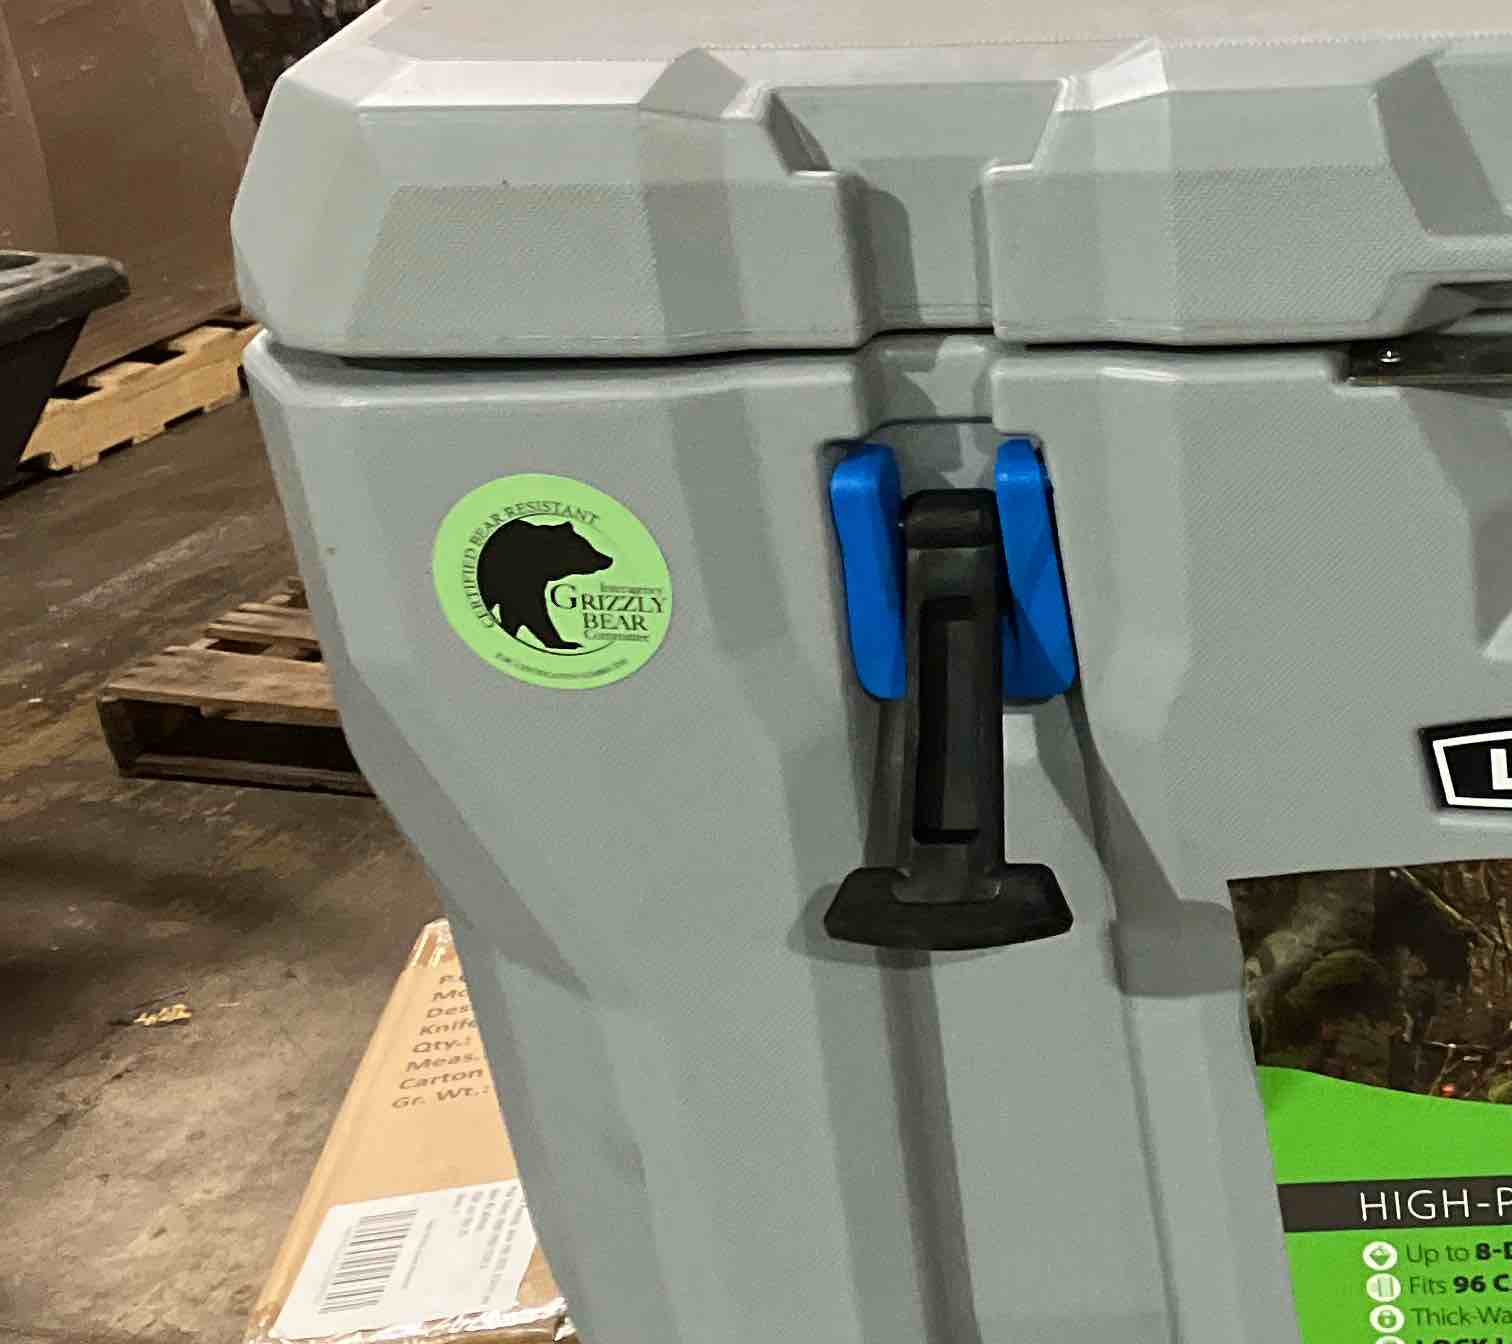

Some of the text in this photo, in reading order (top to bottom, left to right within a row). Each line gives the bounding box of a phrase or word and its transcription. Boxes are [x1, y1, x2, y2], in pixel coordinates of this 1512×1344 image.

[503, 500, 601, 526] RESISTANT
[550, 582, 667, 614] GRIZZLY
[584, 612, 649, 632] BEAR
[399, 1068, 484, 1090] Carton
[1406, 1244, 1440, 1267] Up
[1445, 1243, 1470, 1262] to
[1409, 1275, 1447, 1295] Fits
[1453, 1274, 1487, 1294] 96
